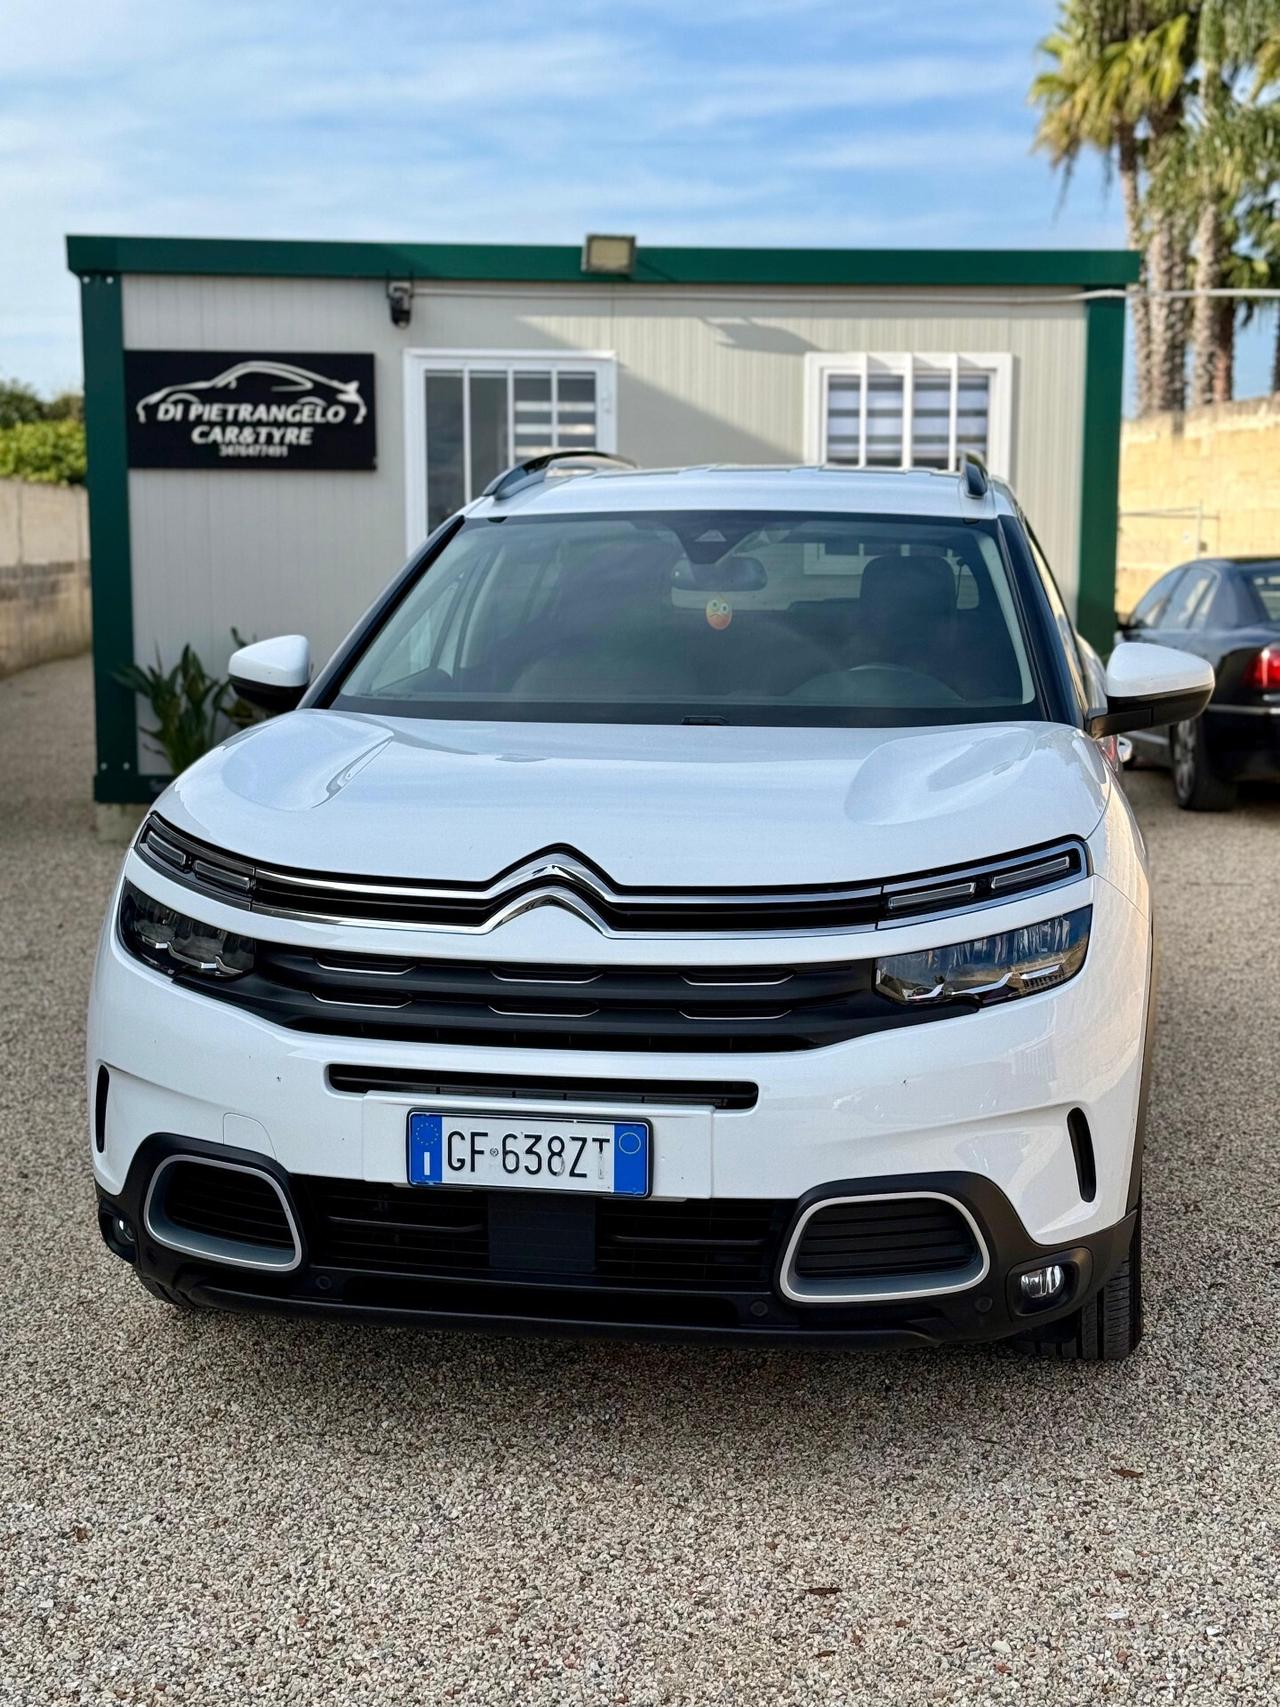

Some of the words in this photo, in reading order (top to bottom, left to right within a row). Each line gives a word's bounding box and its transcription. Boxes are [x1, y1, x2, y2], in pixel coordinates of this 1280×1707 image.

[157, 403, 183, 422] DI
[188, 403, 347, 424] PIETRANGELO
[191, 426, 314, 446] CAR&TYRE
